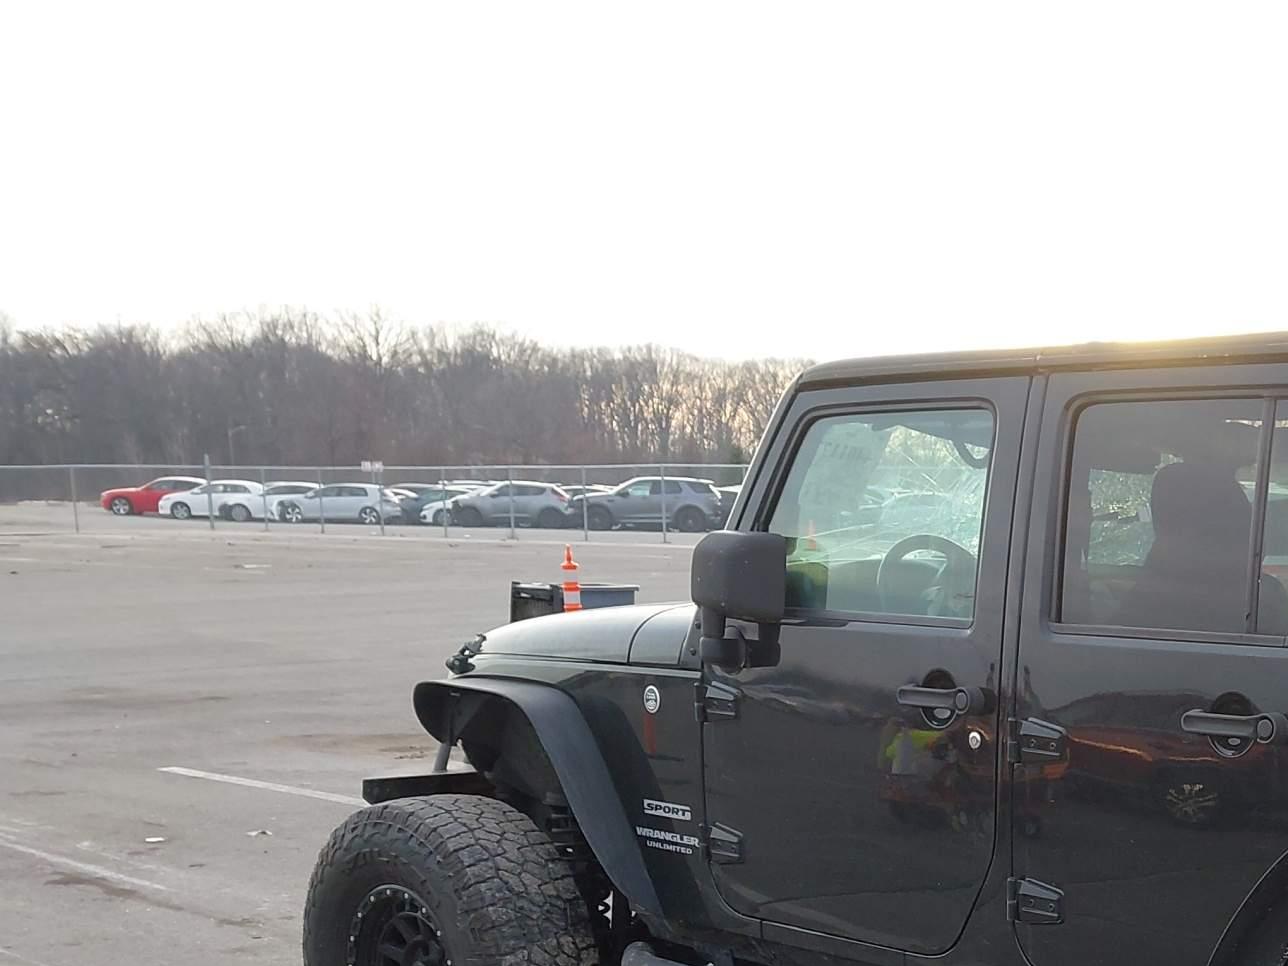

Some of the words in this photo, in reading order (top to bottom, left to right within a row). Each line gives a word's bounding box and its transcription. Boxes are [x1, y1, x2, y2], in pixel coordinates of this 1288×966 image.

[645, 802, 688, 817] SPORT
[635, 826, 700, 848] WRANGLER
[646, 840, 693, 855] UNLIMITED
